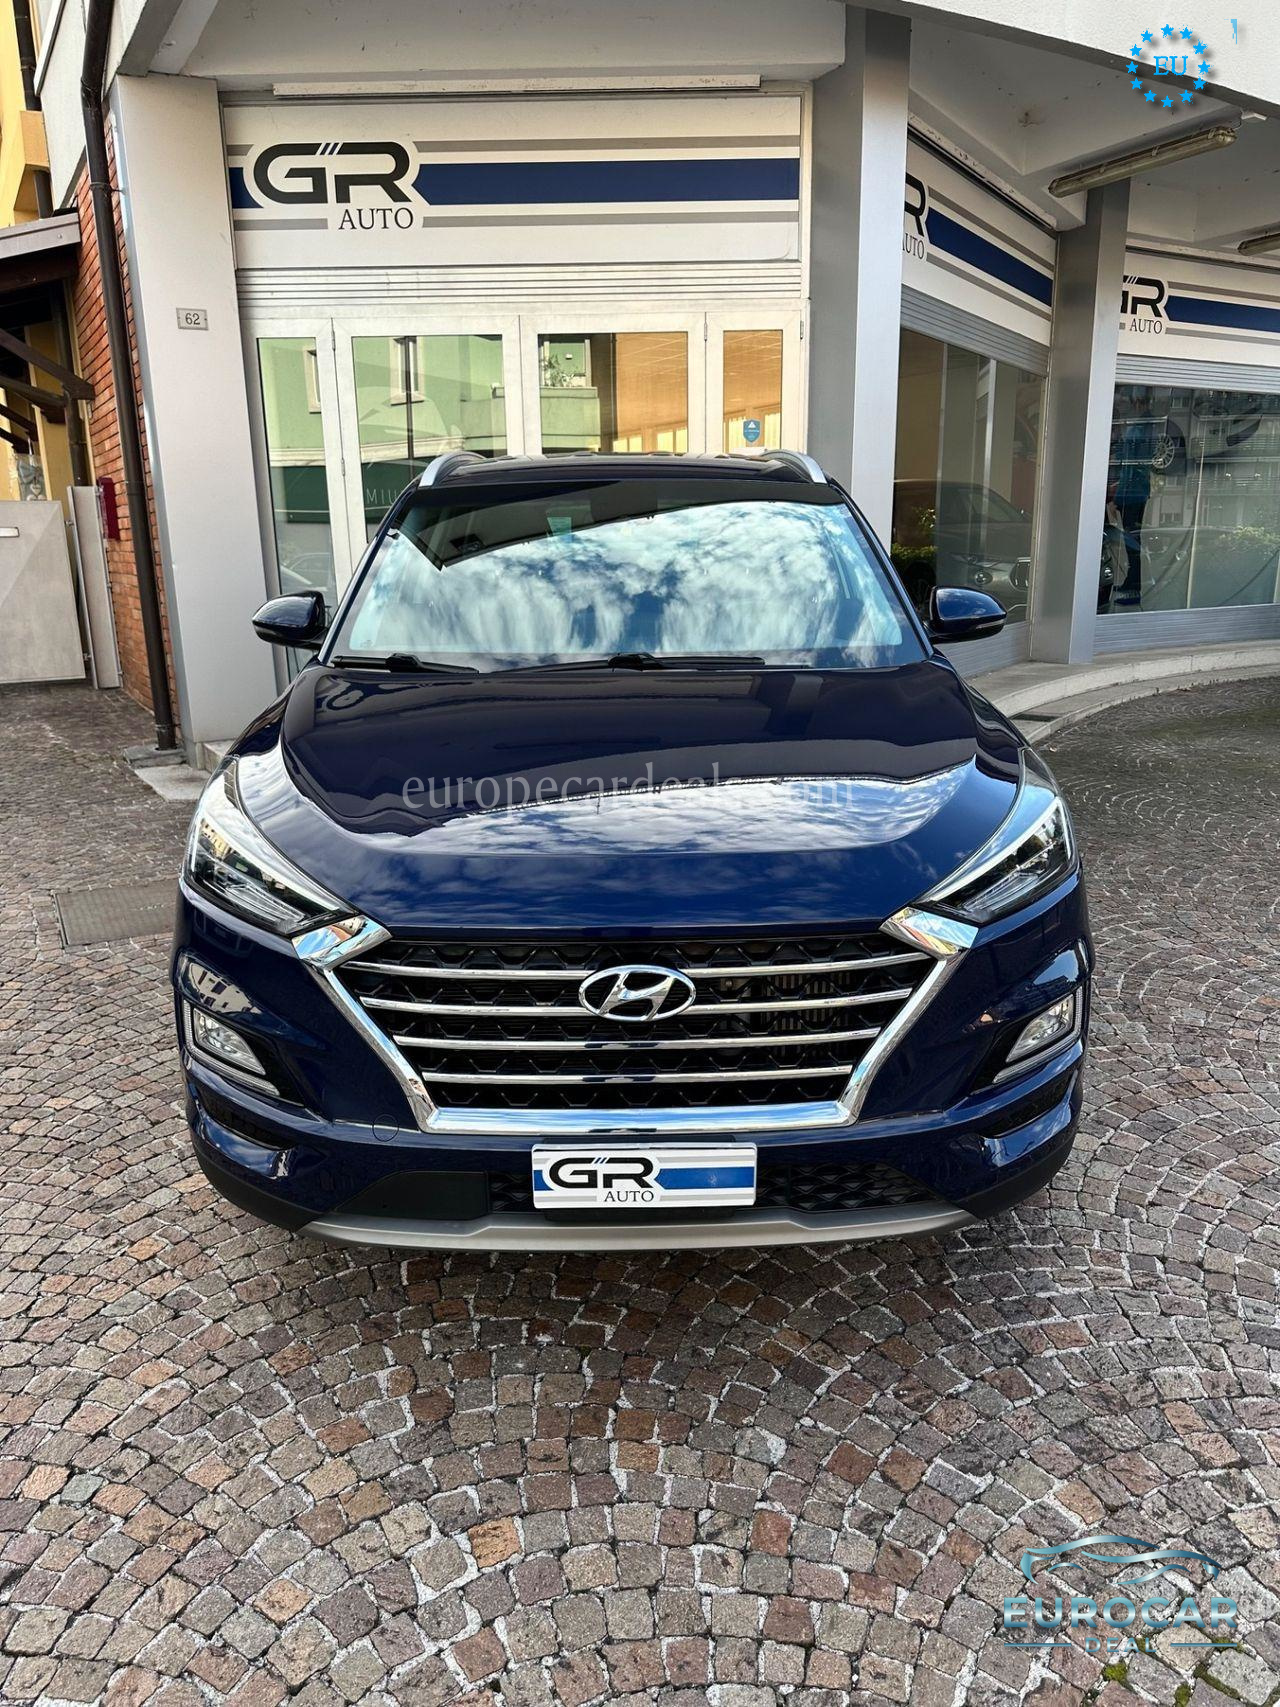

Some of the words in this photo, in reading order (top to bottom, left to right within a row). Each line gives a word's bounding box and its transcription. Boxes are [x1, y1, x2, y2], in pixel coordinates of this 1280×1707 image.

[253, 141, 413, 204] GR
[904, 173, 926, 236] R
[338, 207, 414, 230] AUTO
[185, 312, 201, 325] 62
[1129, 318, 1163, 335] AUTO
[549, 1157, 654, 1188] GR
[604, 1190, 654, 1203] AUTO
